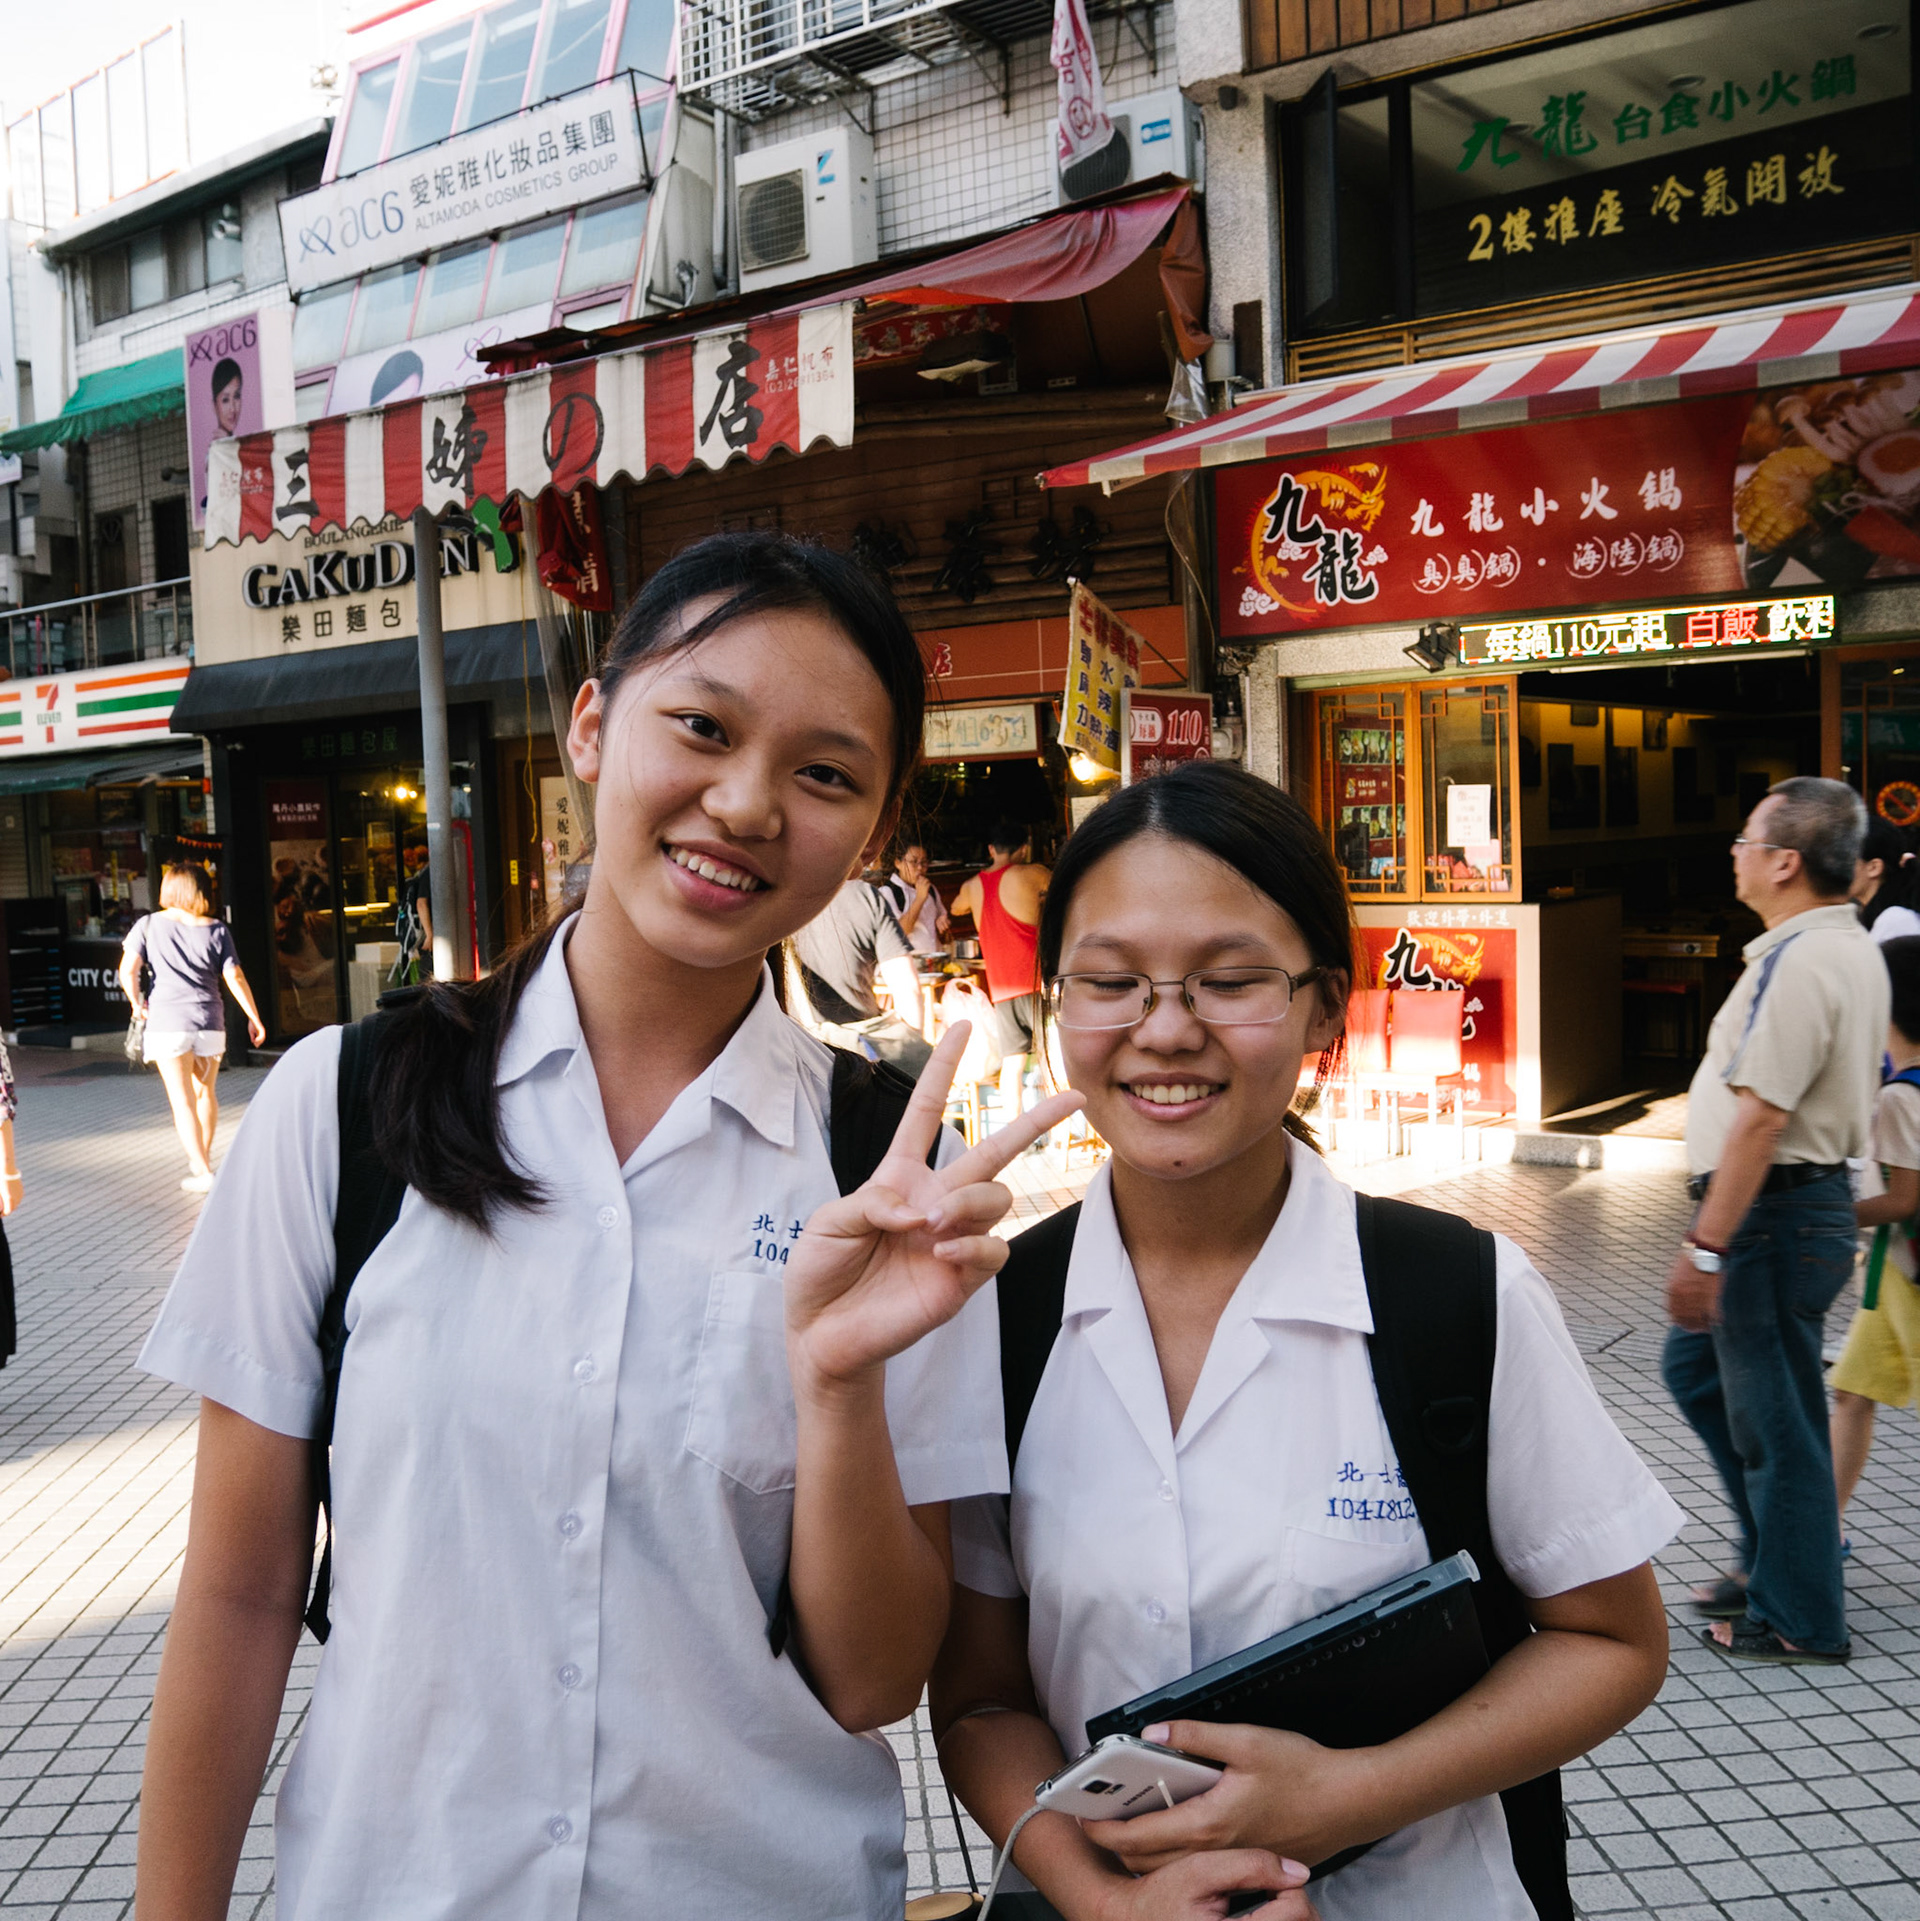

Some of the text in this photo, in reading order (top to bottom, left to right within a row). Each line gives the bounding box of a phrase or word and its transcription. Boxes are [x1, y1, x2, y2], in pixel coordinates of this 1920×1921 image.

[415, 153, 618, 231] ALTAMODA COSMETICS GROUP
[1409, 466, 1683, 538] 九龍小火鍋
[242, 533, 478, 609] GAKUDN
[1264, 472, 1380, 605] 九龍
[1166, 709, 1203, 746] 110
[68, 967, 100, 987] CITY
[1325, 1497, 1416, 1521] 1041812
